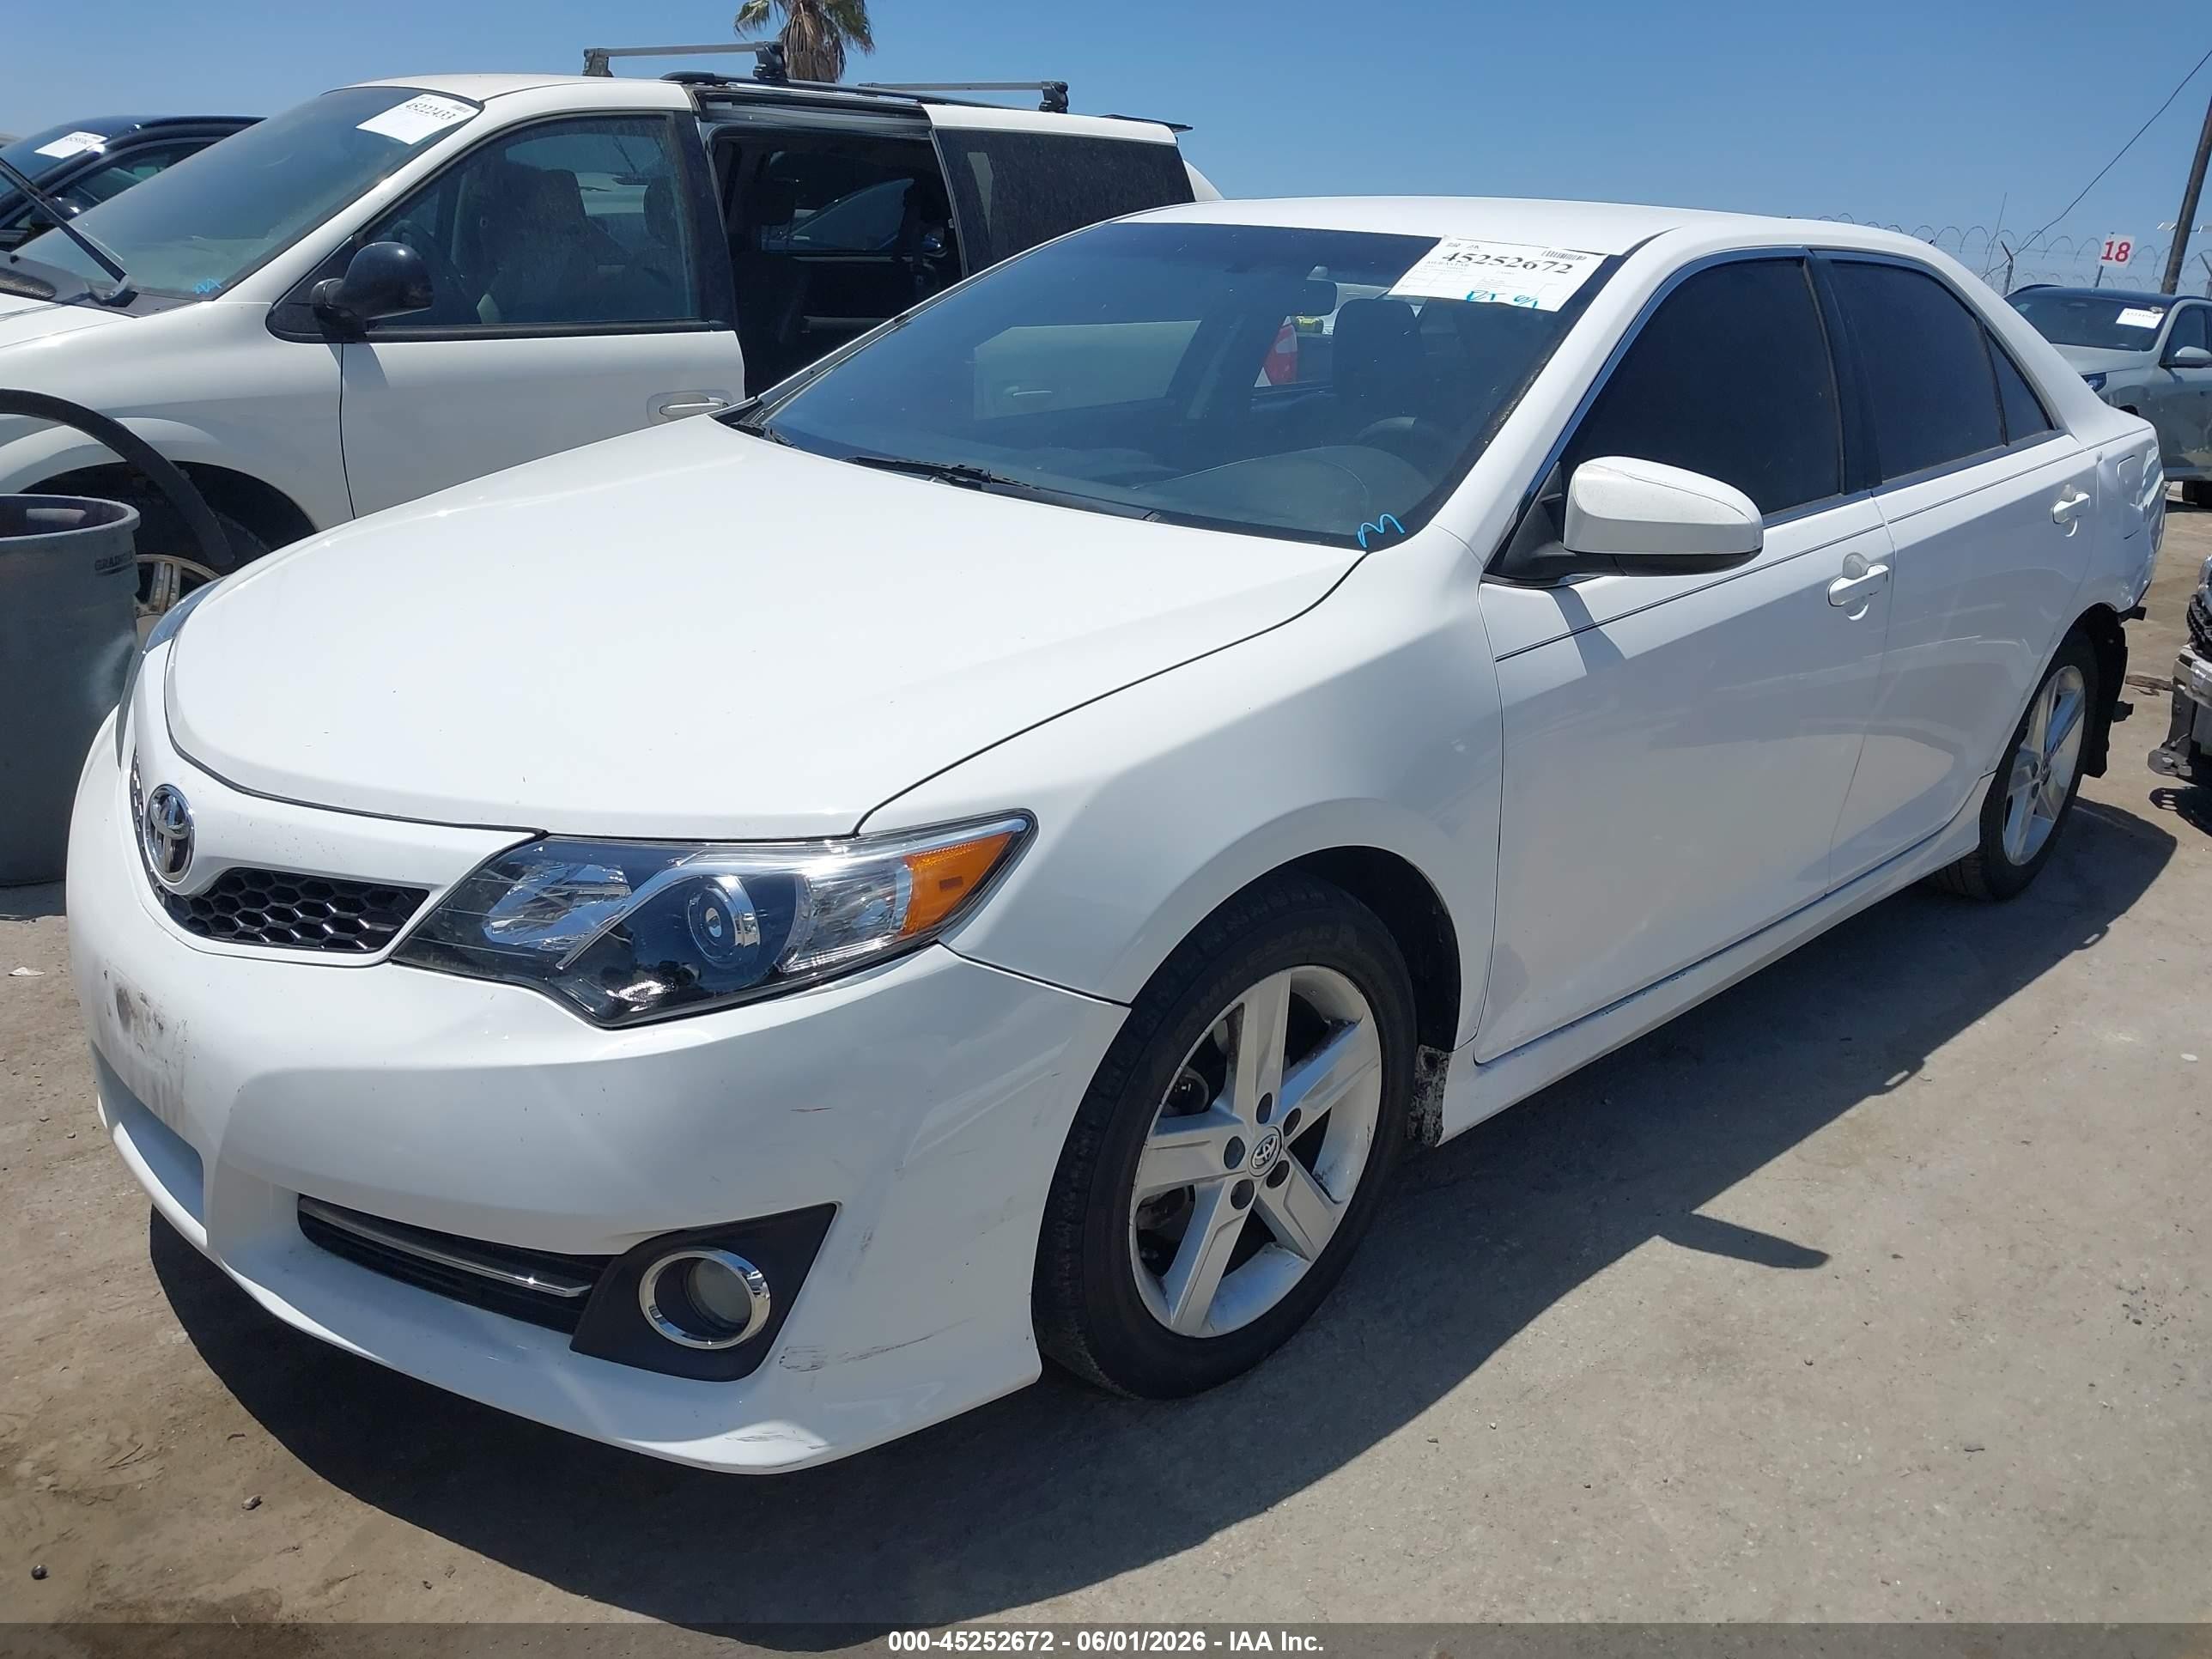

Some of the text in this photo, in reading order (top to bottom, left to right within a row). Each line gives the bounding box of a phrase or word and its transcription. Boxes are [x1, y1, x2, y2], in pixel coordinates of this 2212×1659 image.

[1442, 251, 1574, 275] 45252672
[2100, 240, 2131, 263] 18
[1357, 514, 1406, 549] M
